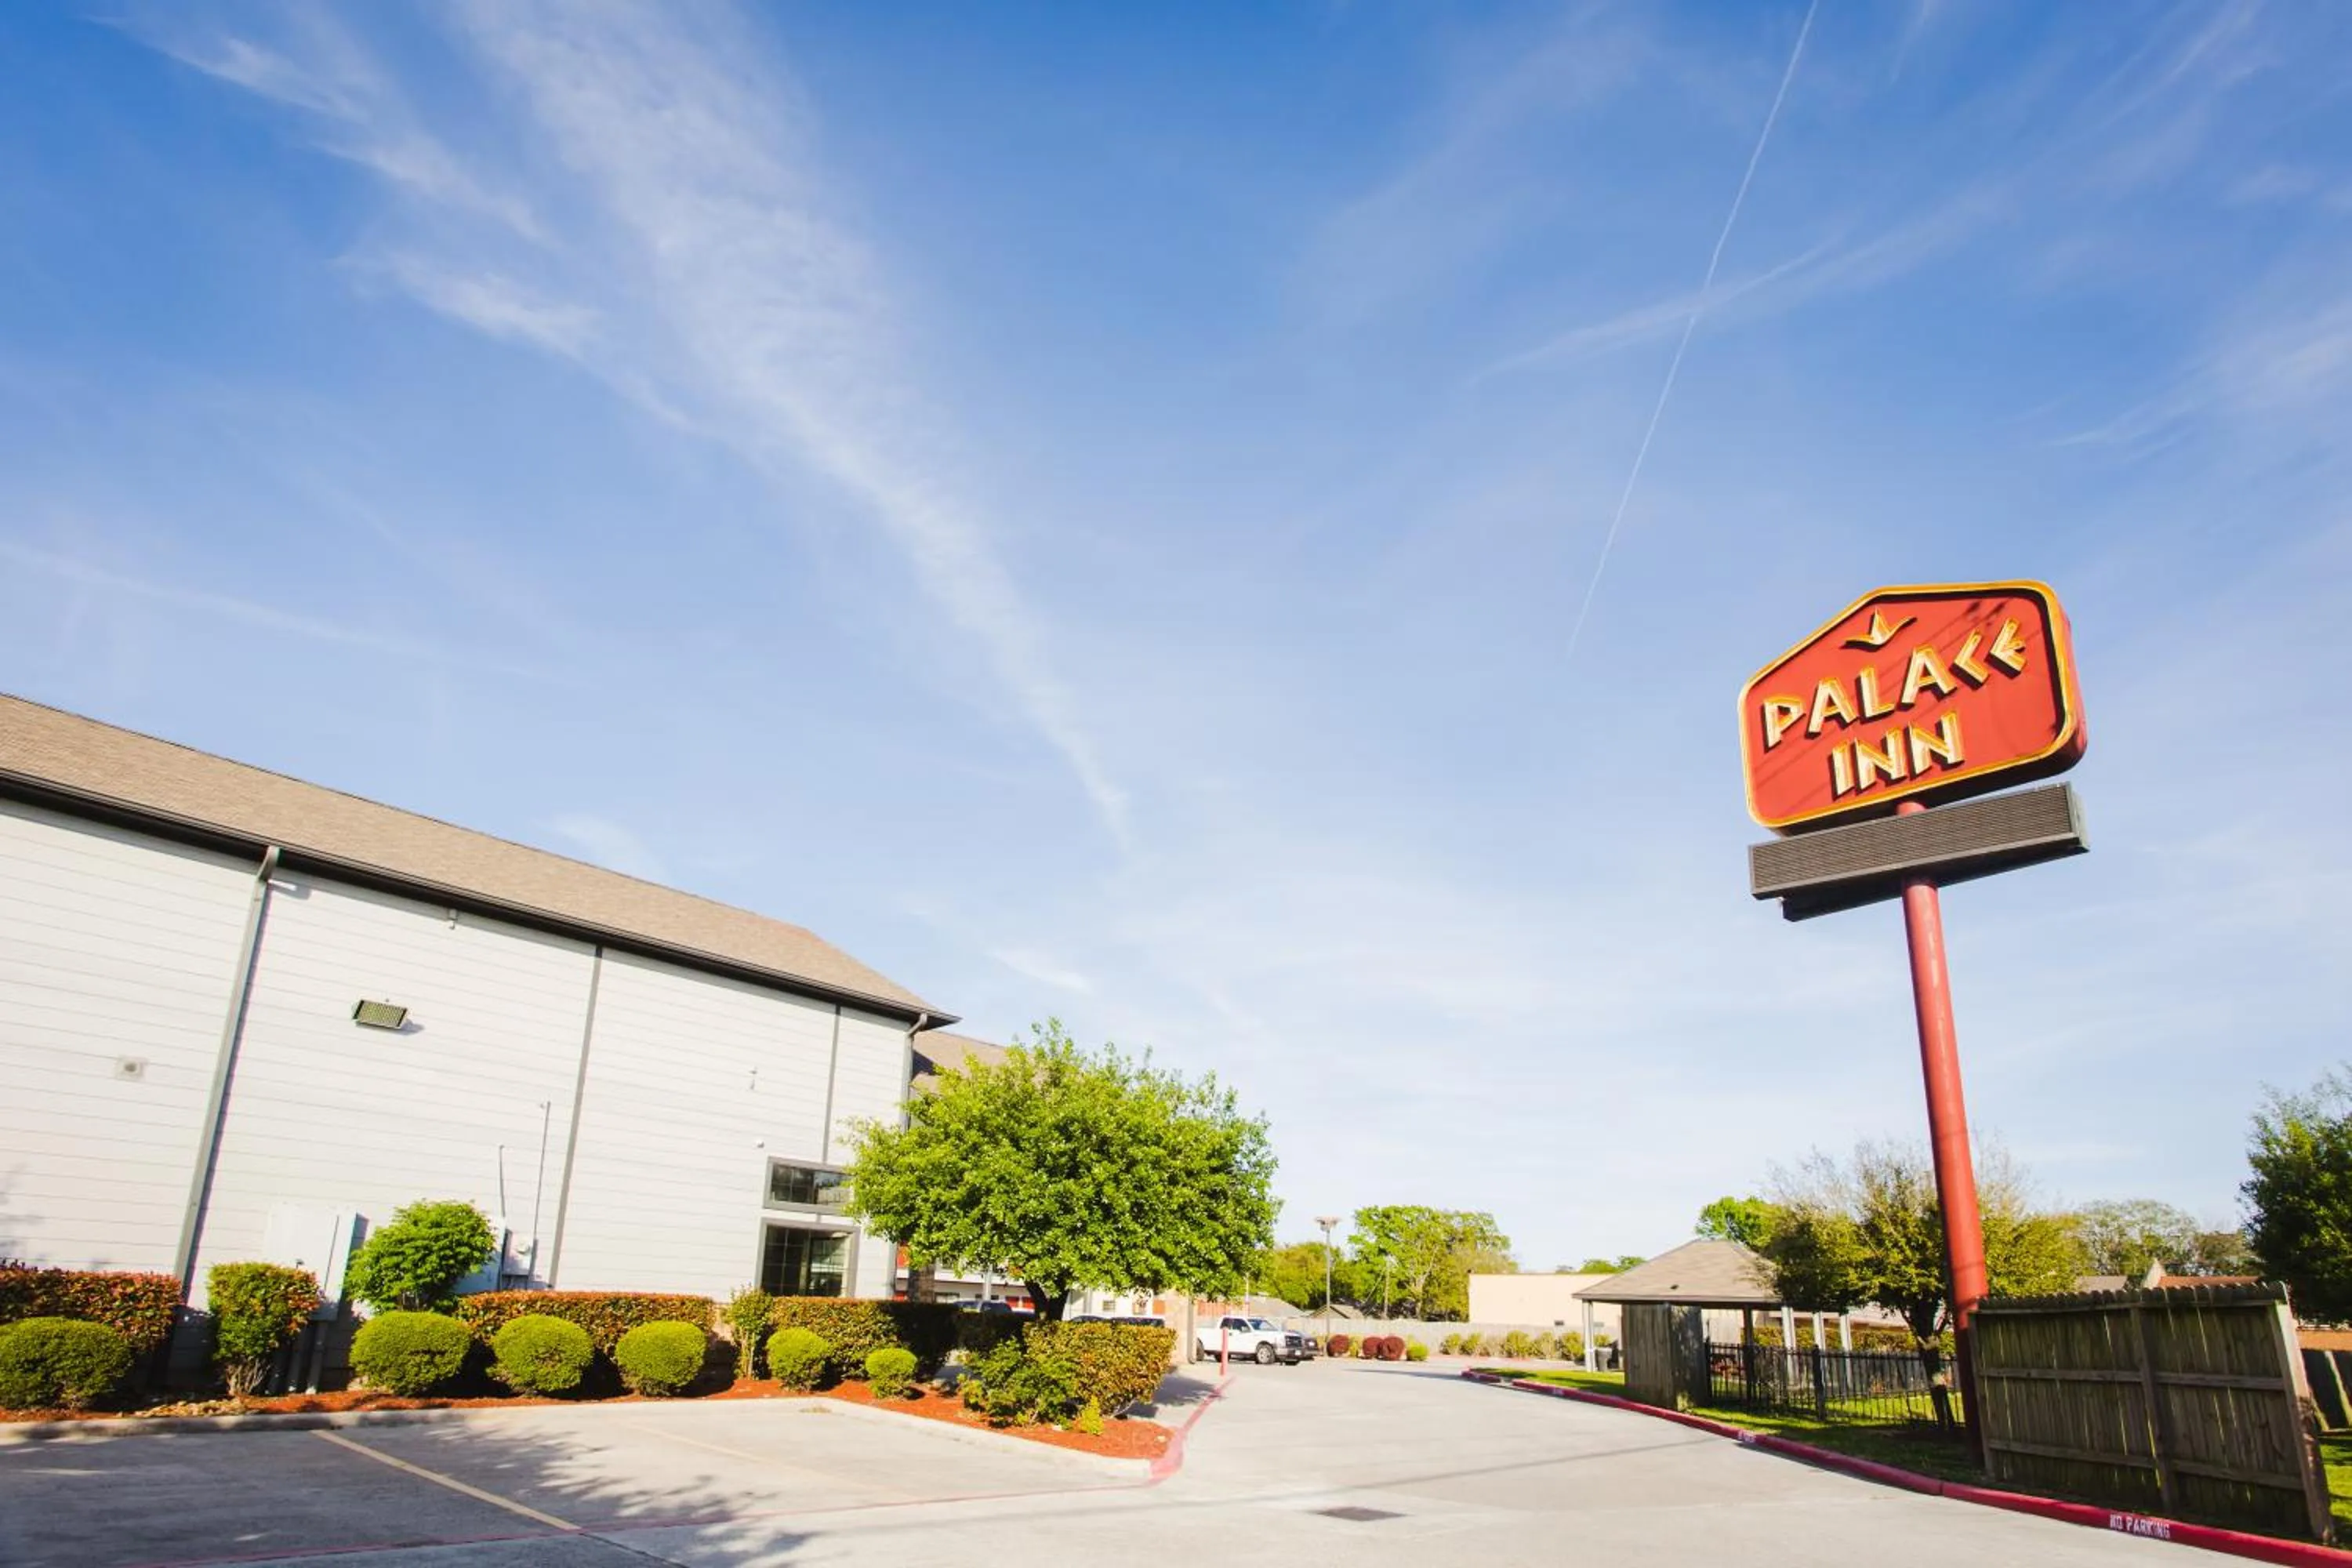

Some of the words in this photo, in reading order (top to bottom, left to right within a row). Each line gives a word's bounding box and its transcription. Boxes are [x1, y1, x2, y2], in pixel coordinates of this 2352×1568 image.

[1762, 616, 2027, 750] PALACE
[1831, 710, 1965, 798] INN
[2110, 1514, 2122, 1530] NO
[2125, 1516, 2170, 1539] PARKING
